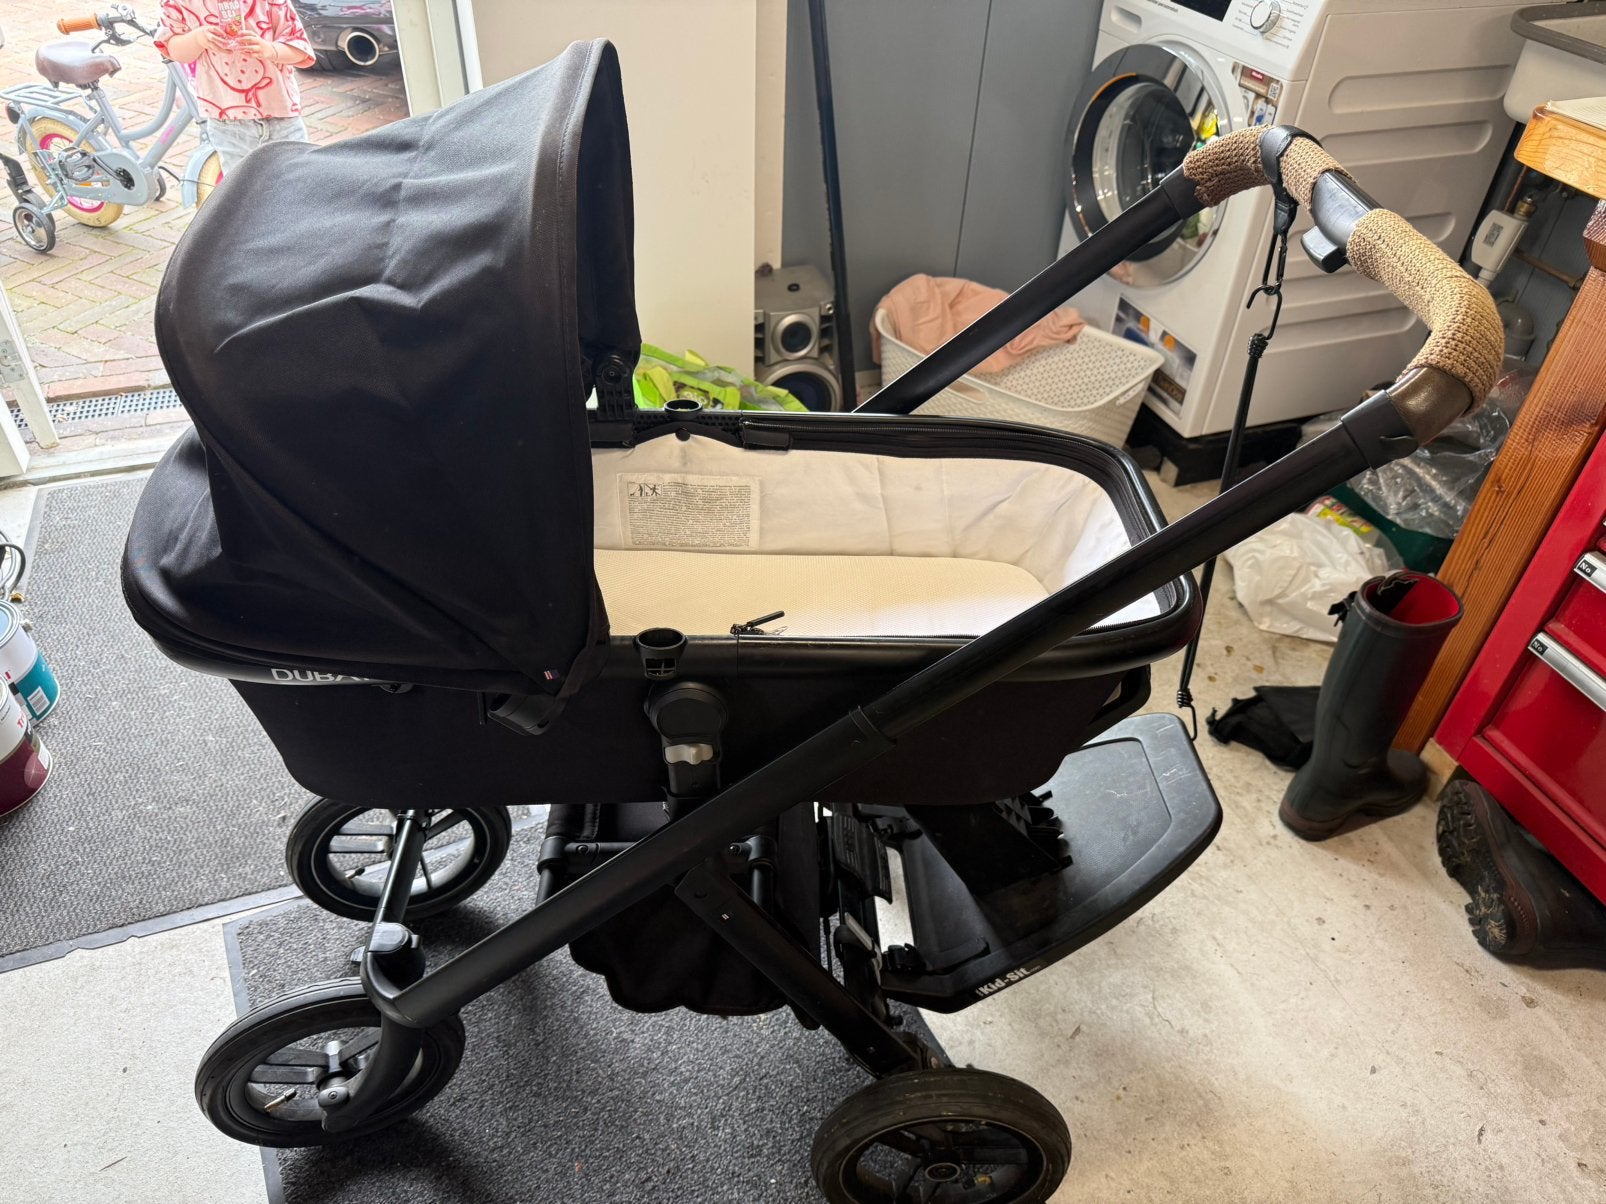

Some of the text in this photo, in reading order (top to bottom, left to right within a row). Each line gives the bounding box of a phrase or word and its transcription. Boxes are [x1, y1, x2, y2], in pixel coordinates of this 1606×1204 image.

[1579, 562, 1591, 574] No
[1532, 641, 1544, 652] No
[271, 668, 369, 682] DUBA
[978, 967, 1031, 995] Kid-Sit
